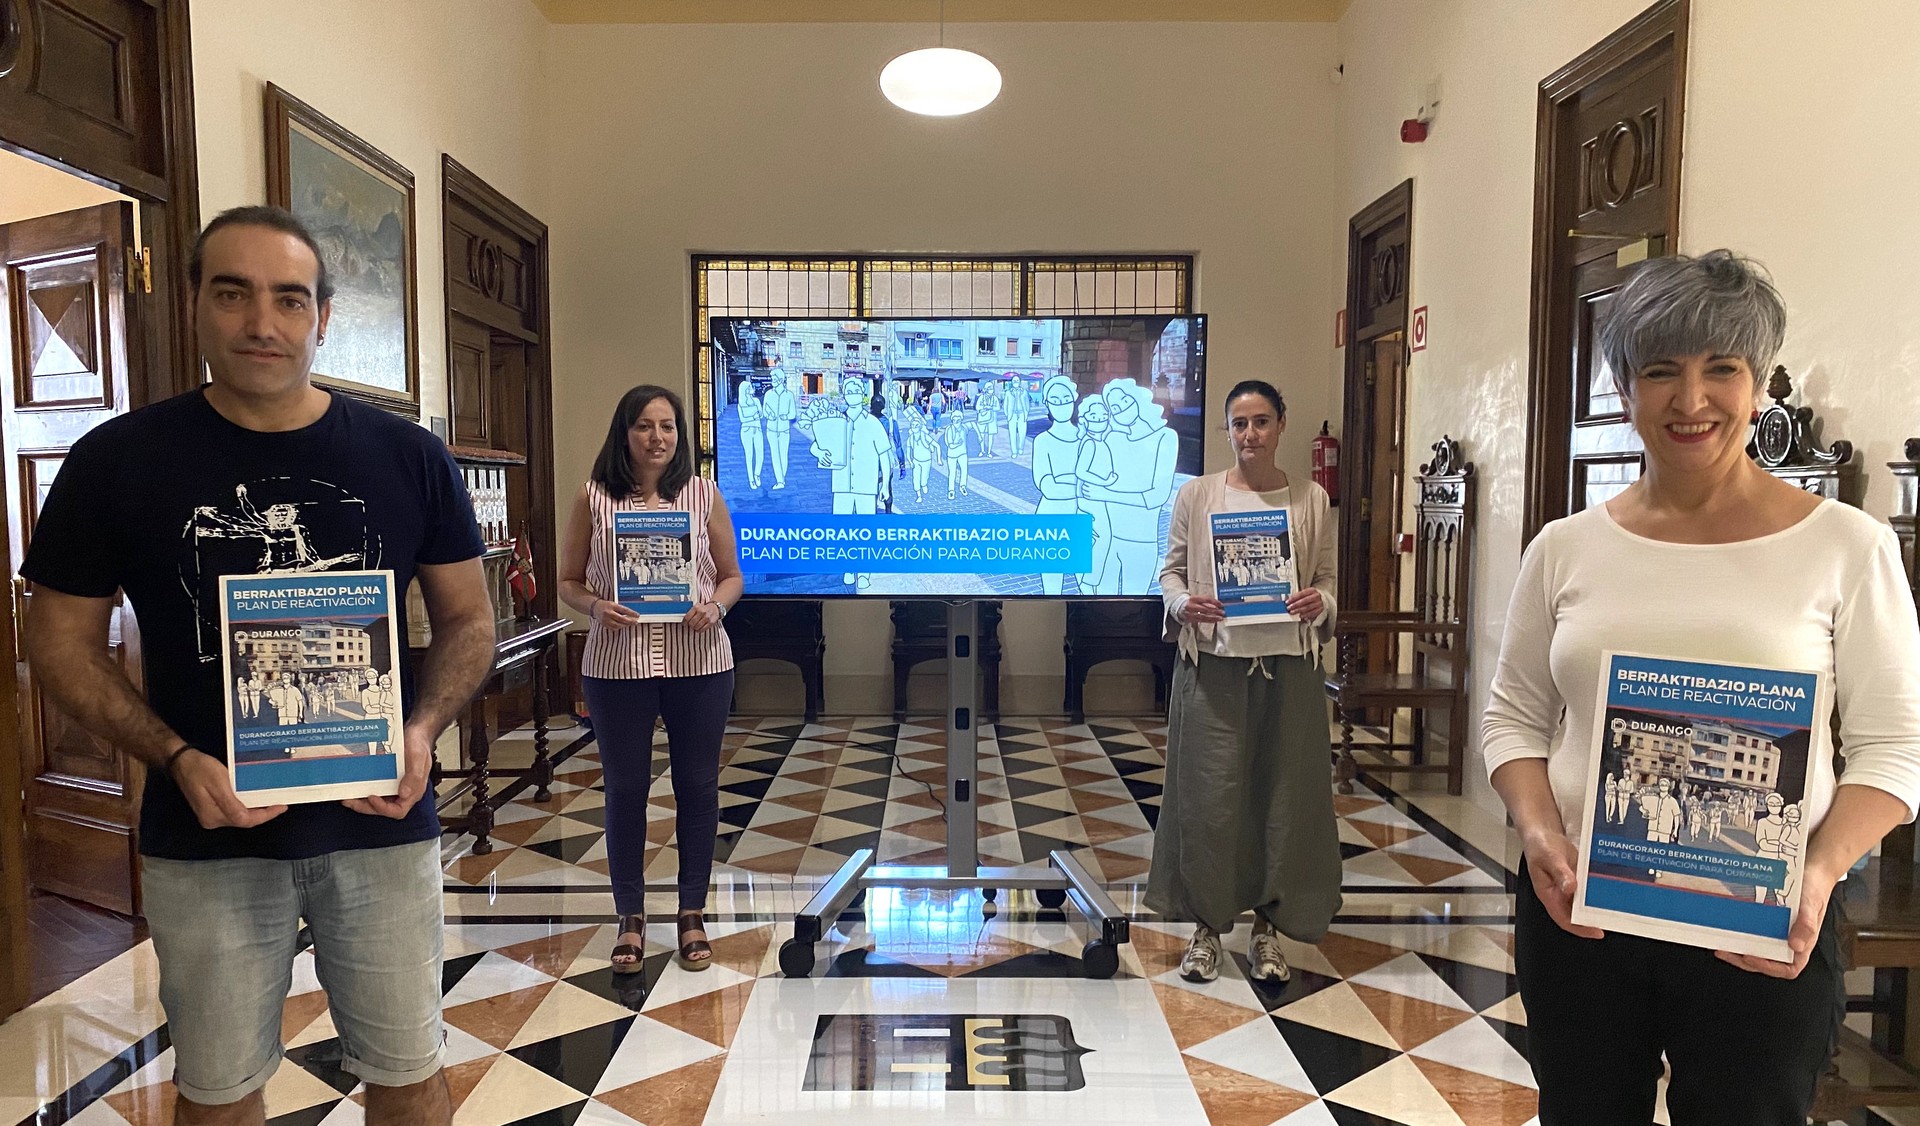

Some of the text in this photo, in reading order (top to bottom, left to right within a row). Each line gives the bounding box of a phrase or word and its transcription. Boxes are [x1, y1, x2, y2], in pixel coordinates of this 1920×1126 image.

[741, 528, 1070, 541] DURANGORAKO BERRAKTIBAZIO PLANA
[741, 544, 1070, 560] PLAN DE REACTIVACIÓN PARA DURANGO
[233, 586, 381, 599] BERRAKTIBAZIO PLANA
[237, 596, 375, 610] PLAN DE REACTIVACIÓN
[251, 629, 302, 638] DURANGO
[1617, 669, 1806, 699] BERRAKTIBAZIO PLANA
[1619, 683, 1796, 712] PLAN DE REACTIVACIÓN
[240, 730, 296, 739] DURANGORAKO
[298, 726, 353, 734] BERRAKTIBAZIO
[1631, 721, 1694, 737] DURANGO
[1598, 839, 1773, 872] DURANGORAKO BERRAKTIBAZIO PLANA
[1597, 848, 1620, 859] PLAN
[1621, 852, 1633, 861] DE
[1700, 864, 1723, 874] PARA
[1725, 868, 1773, 882] DURANGO
